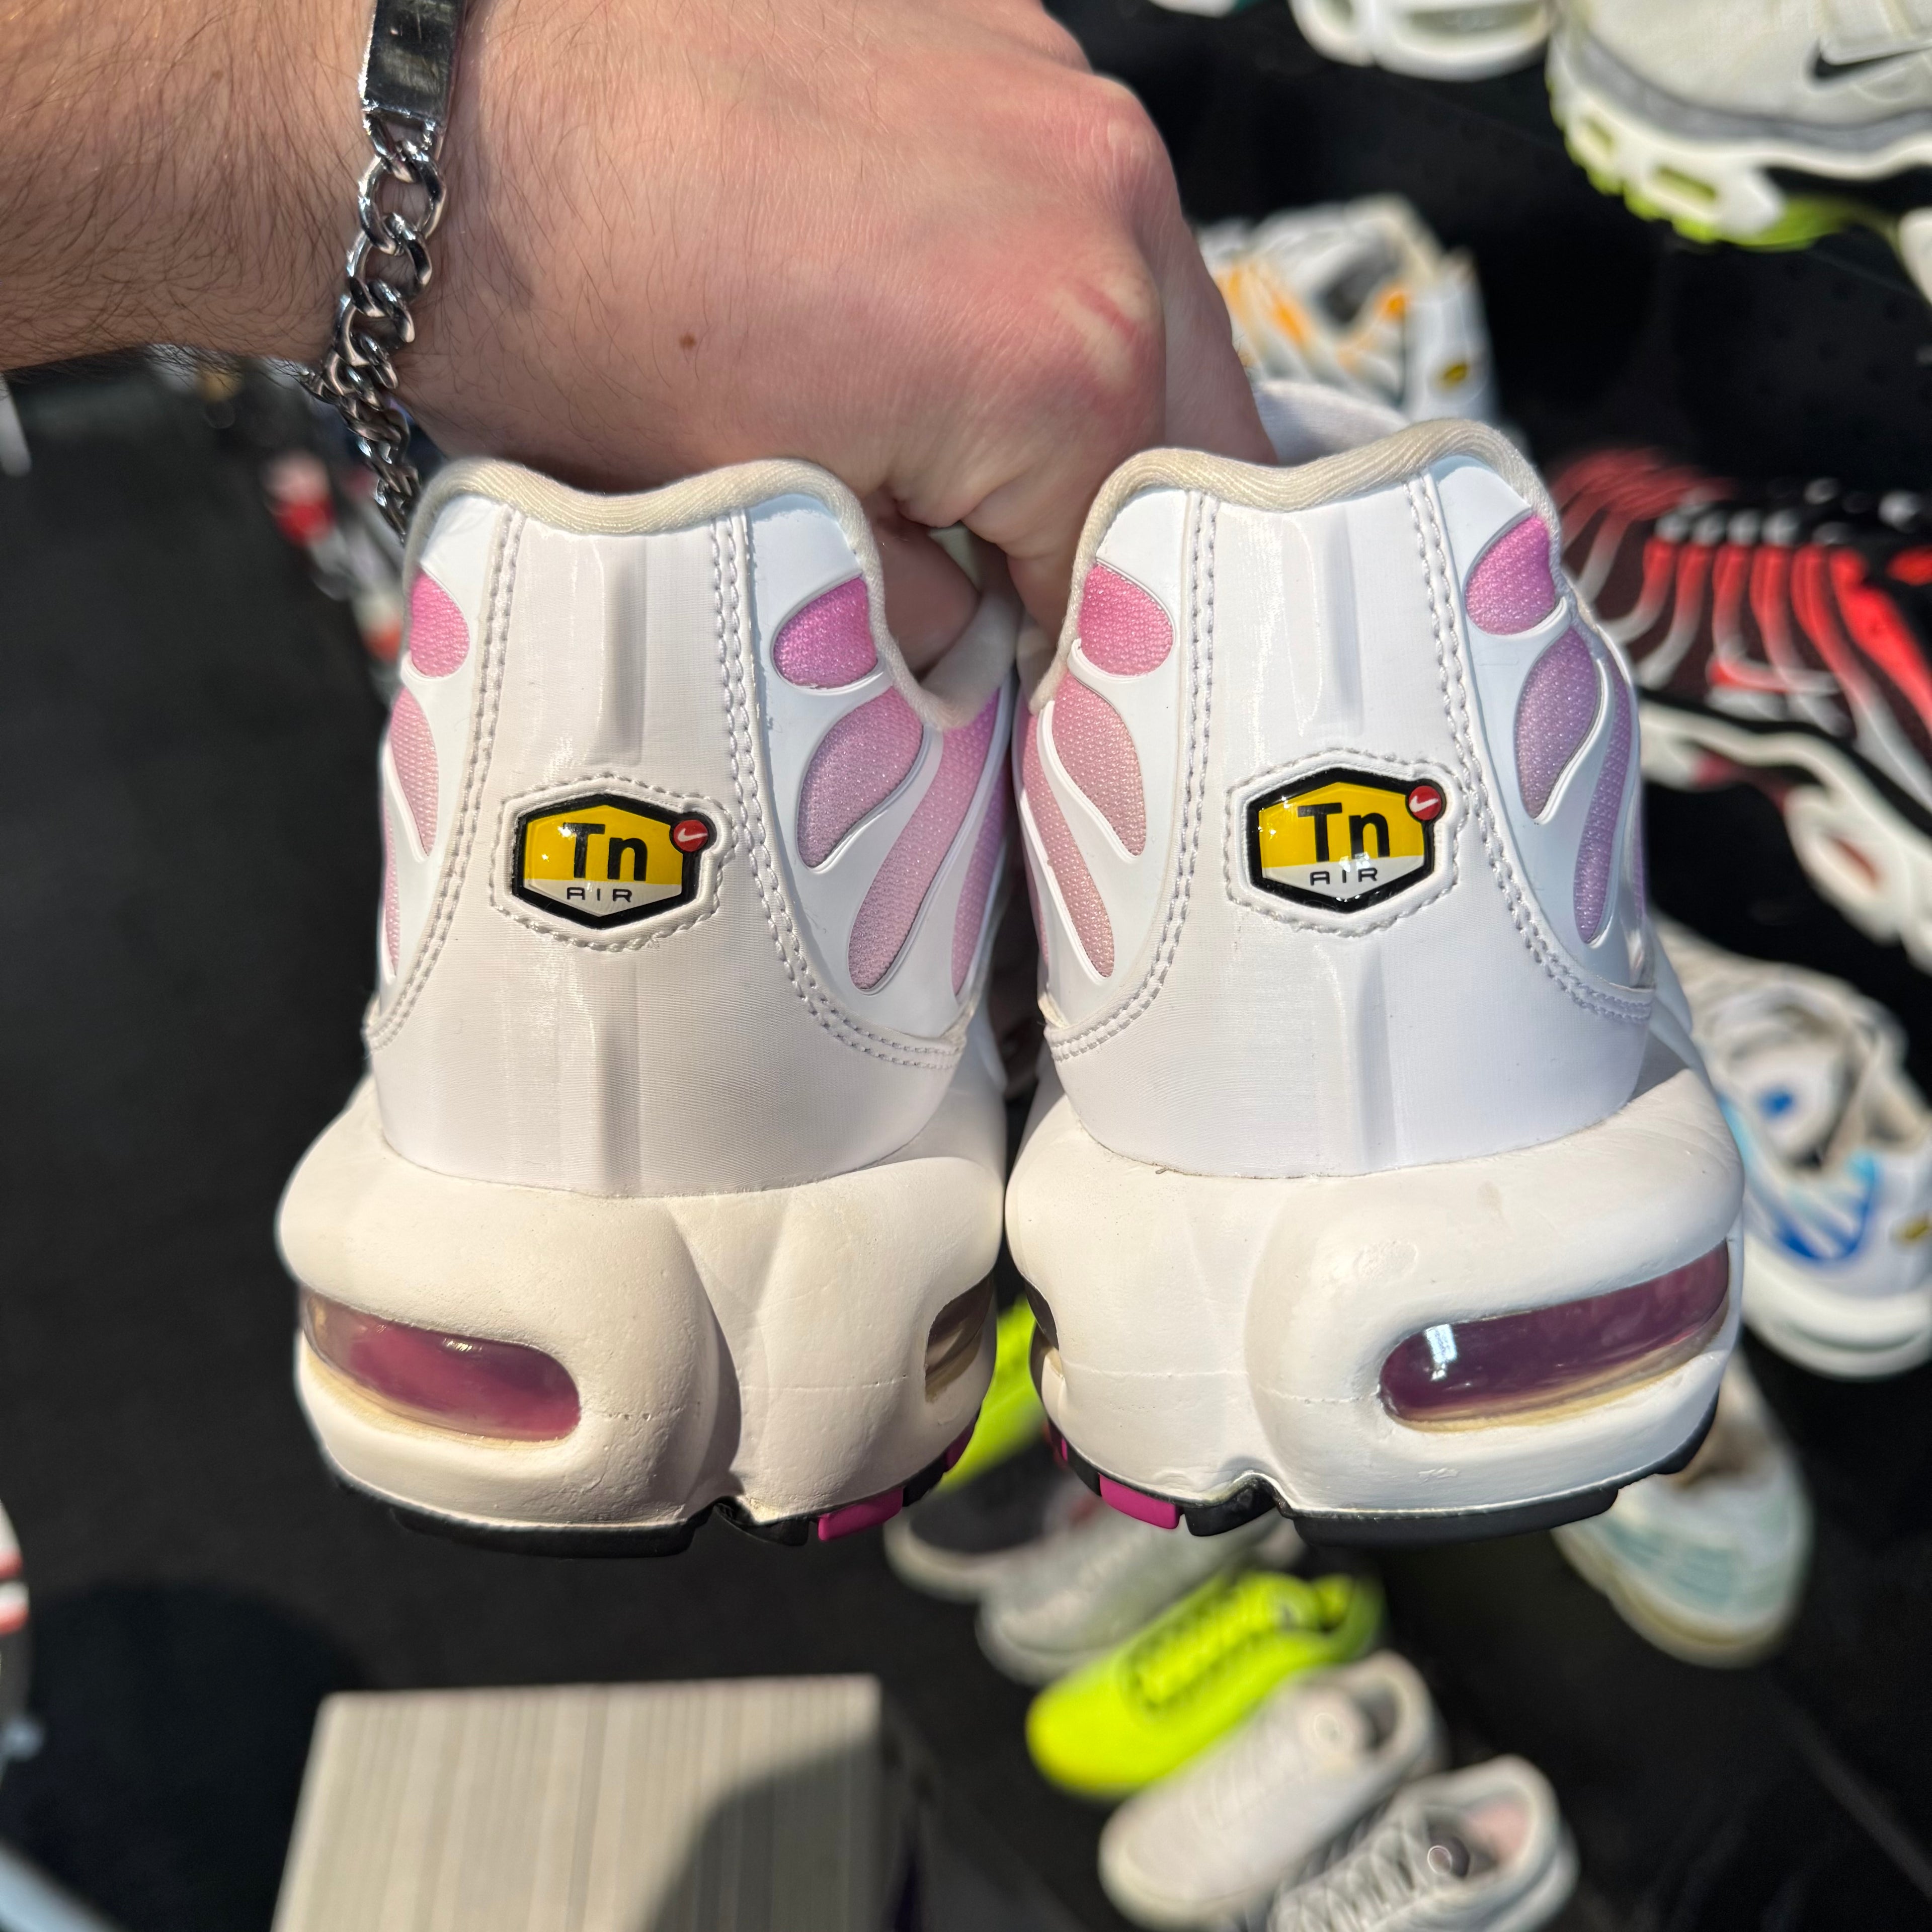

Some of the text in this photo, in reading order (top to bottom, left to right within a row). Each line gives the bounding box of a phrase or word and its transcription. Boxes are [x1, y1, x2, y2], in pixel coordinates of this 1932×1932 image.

[562, 822, 648, 881] Tn
[1297, 802, 1390, 862] Tn
[566, 887, 632, 903] AIR
[1310, 867, 1378, 886] AIR
